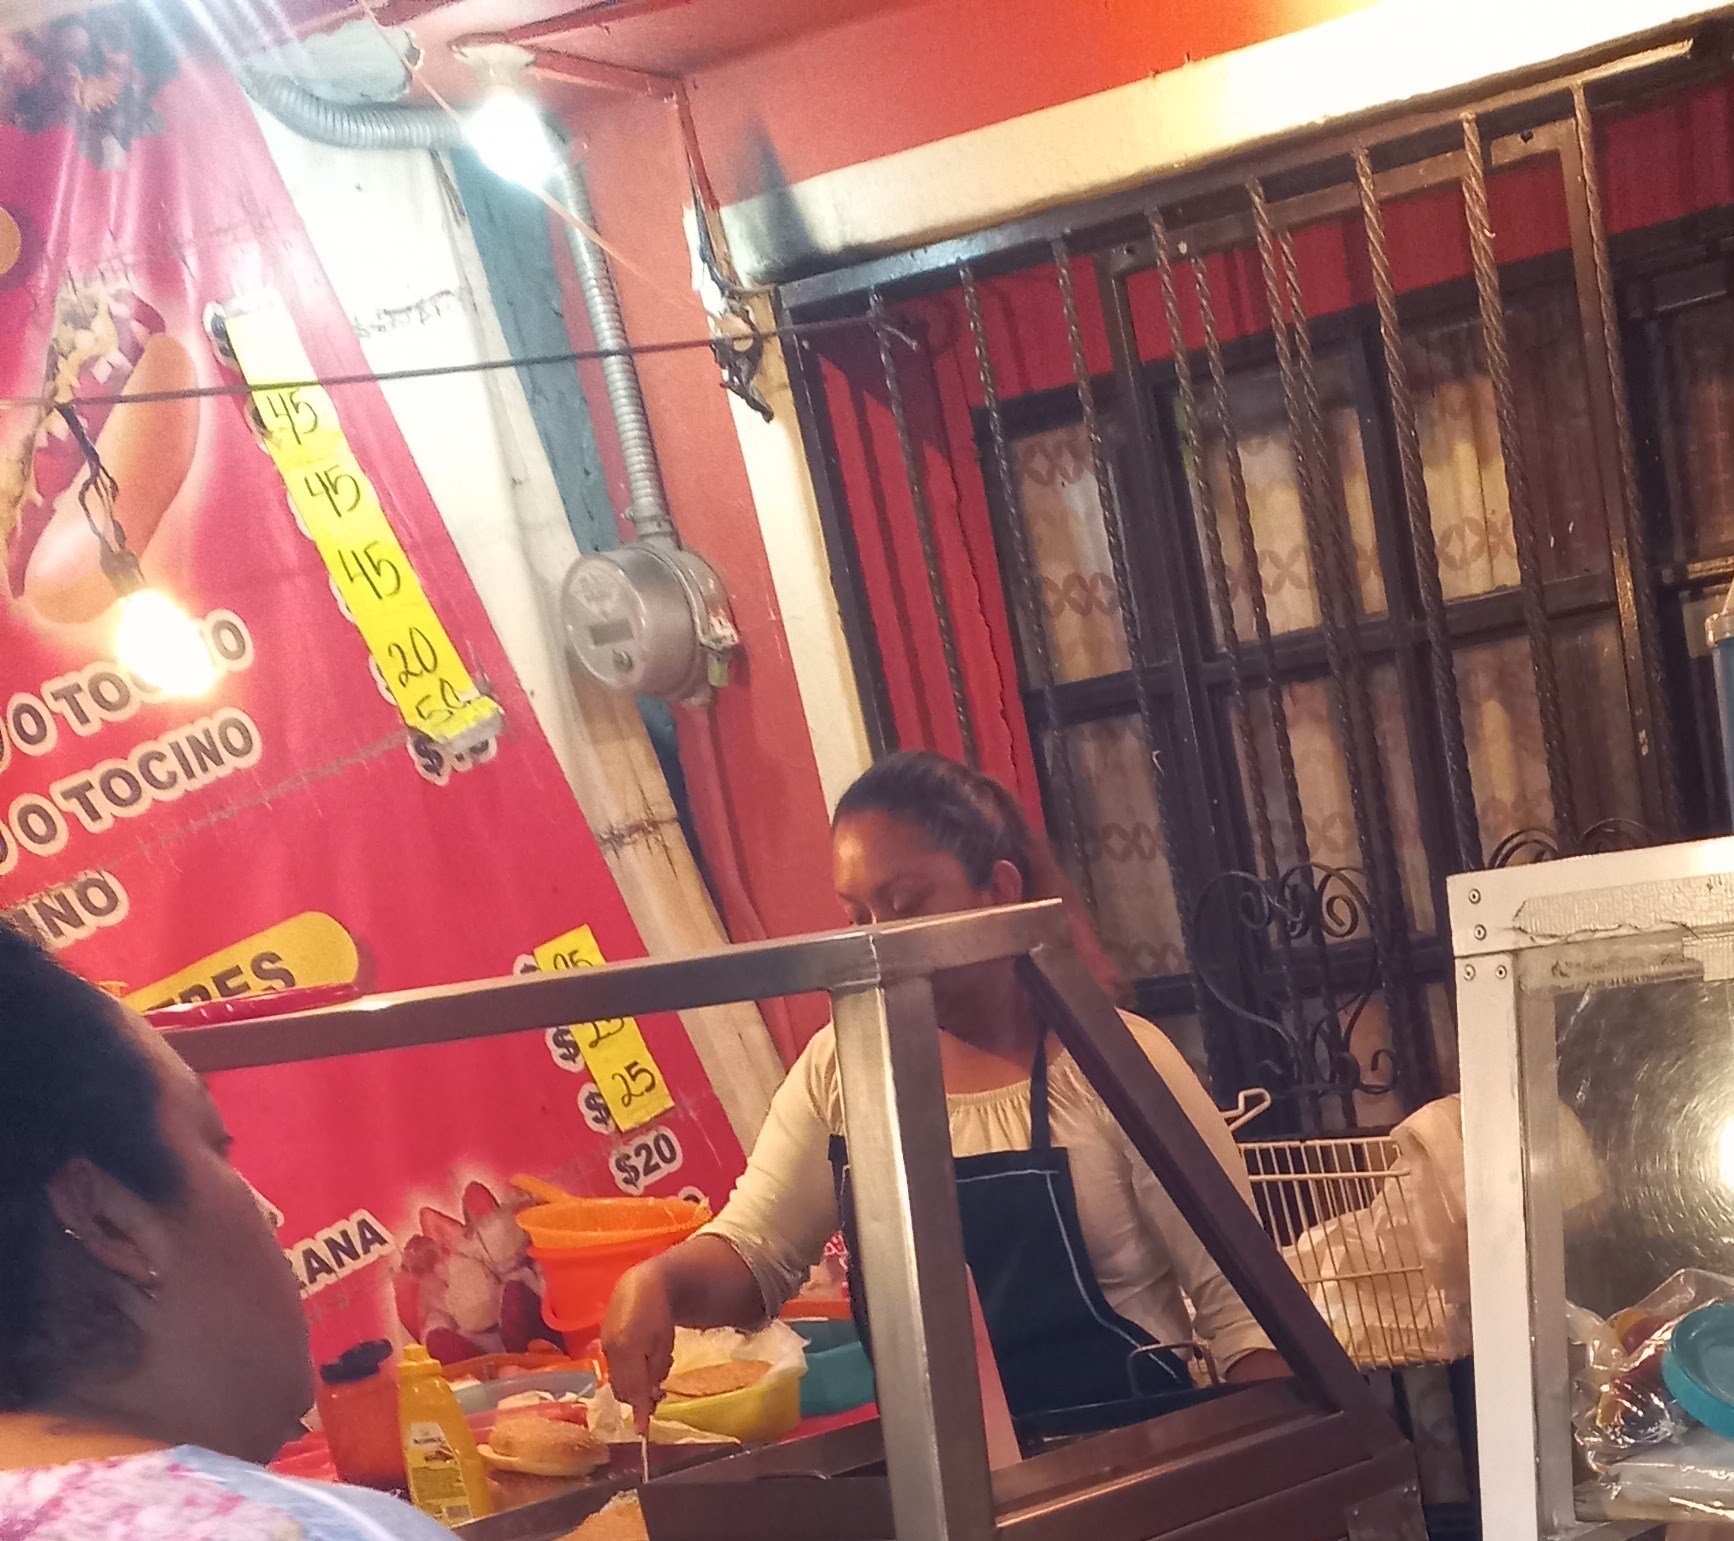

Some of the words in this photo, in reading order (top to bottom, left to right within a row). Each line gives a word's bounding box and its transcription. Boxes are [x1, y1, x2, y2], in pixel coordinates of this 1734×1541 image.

[267, 389, 319, 446] 45
[304, 464, 362, 518] 45
[338, 541, 402, 601] 45
[387, 626, 439, 688] 20
[61, 716, 253, 824] TOCINO
[611, 1060, 657, 1108] 25
[614, 1132, 678, 1188] $20
[299, 1217, 389, 1290] ANA
